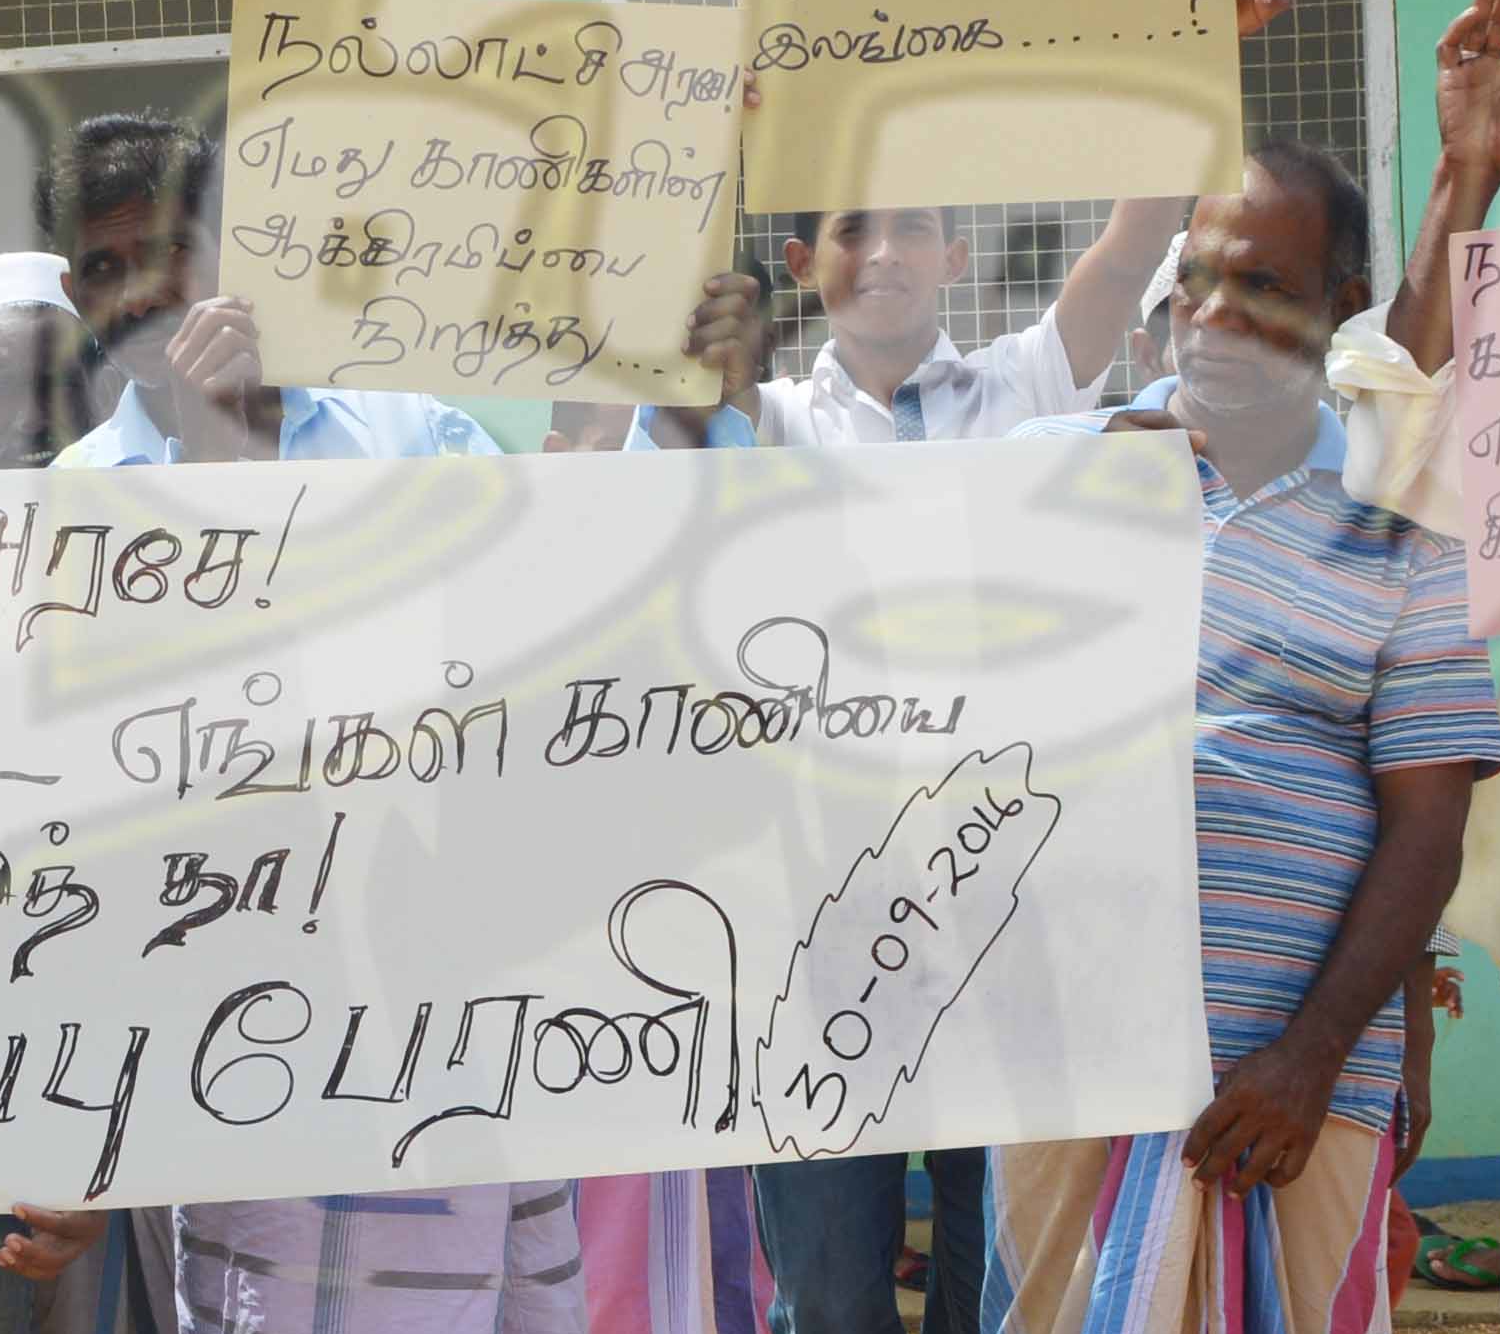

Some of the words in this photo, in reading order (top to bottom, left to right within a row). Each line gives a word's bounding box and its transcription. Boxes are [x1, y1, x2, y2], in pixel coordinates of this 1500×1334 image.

[257, 11, 624, 102] நல்லாட்சி
[237, 116, 395, 199] எமது
[110, 656, 512, 801] எங்கள்
